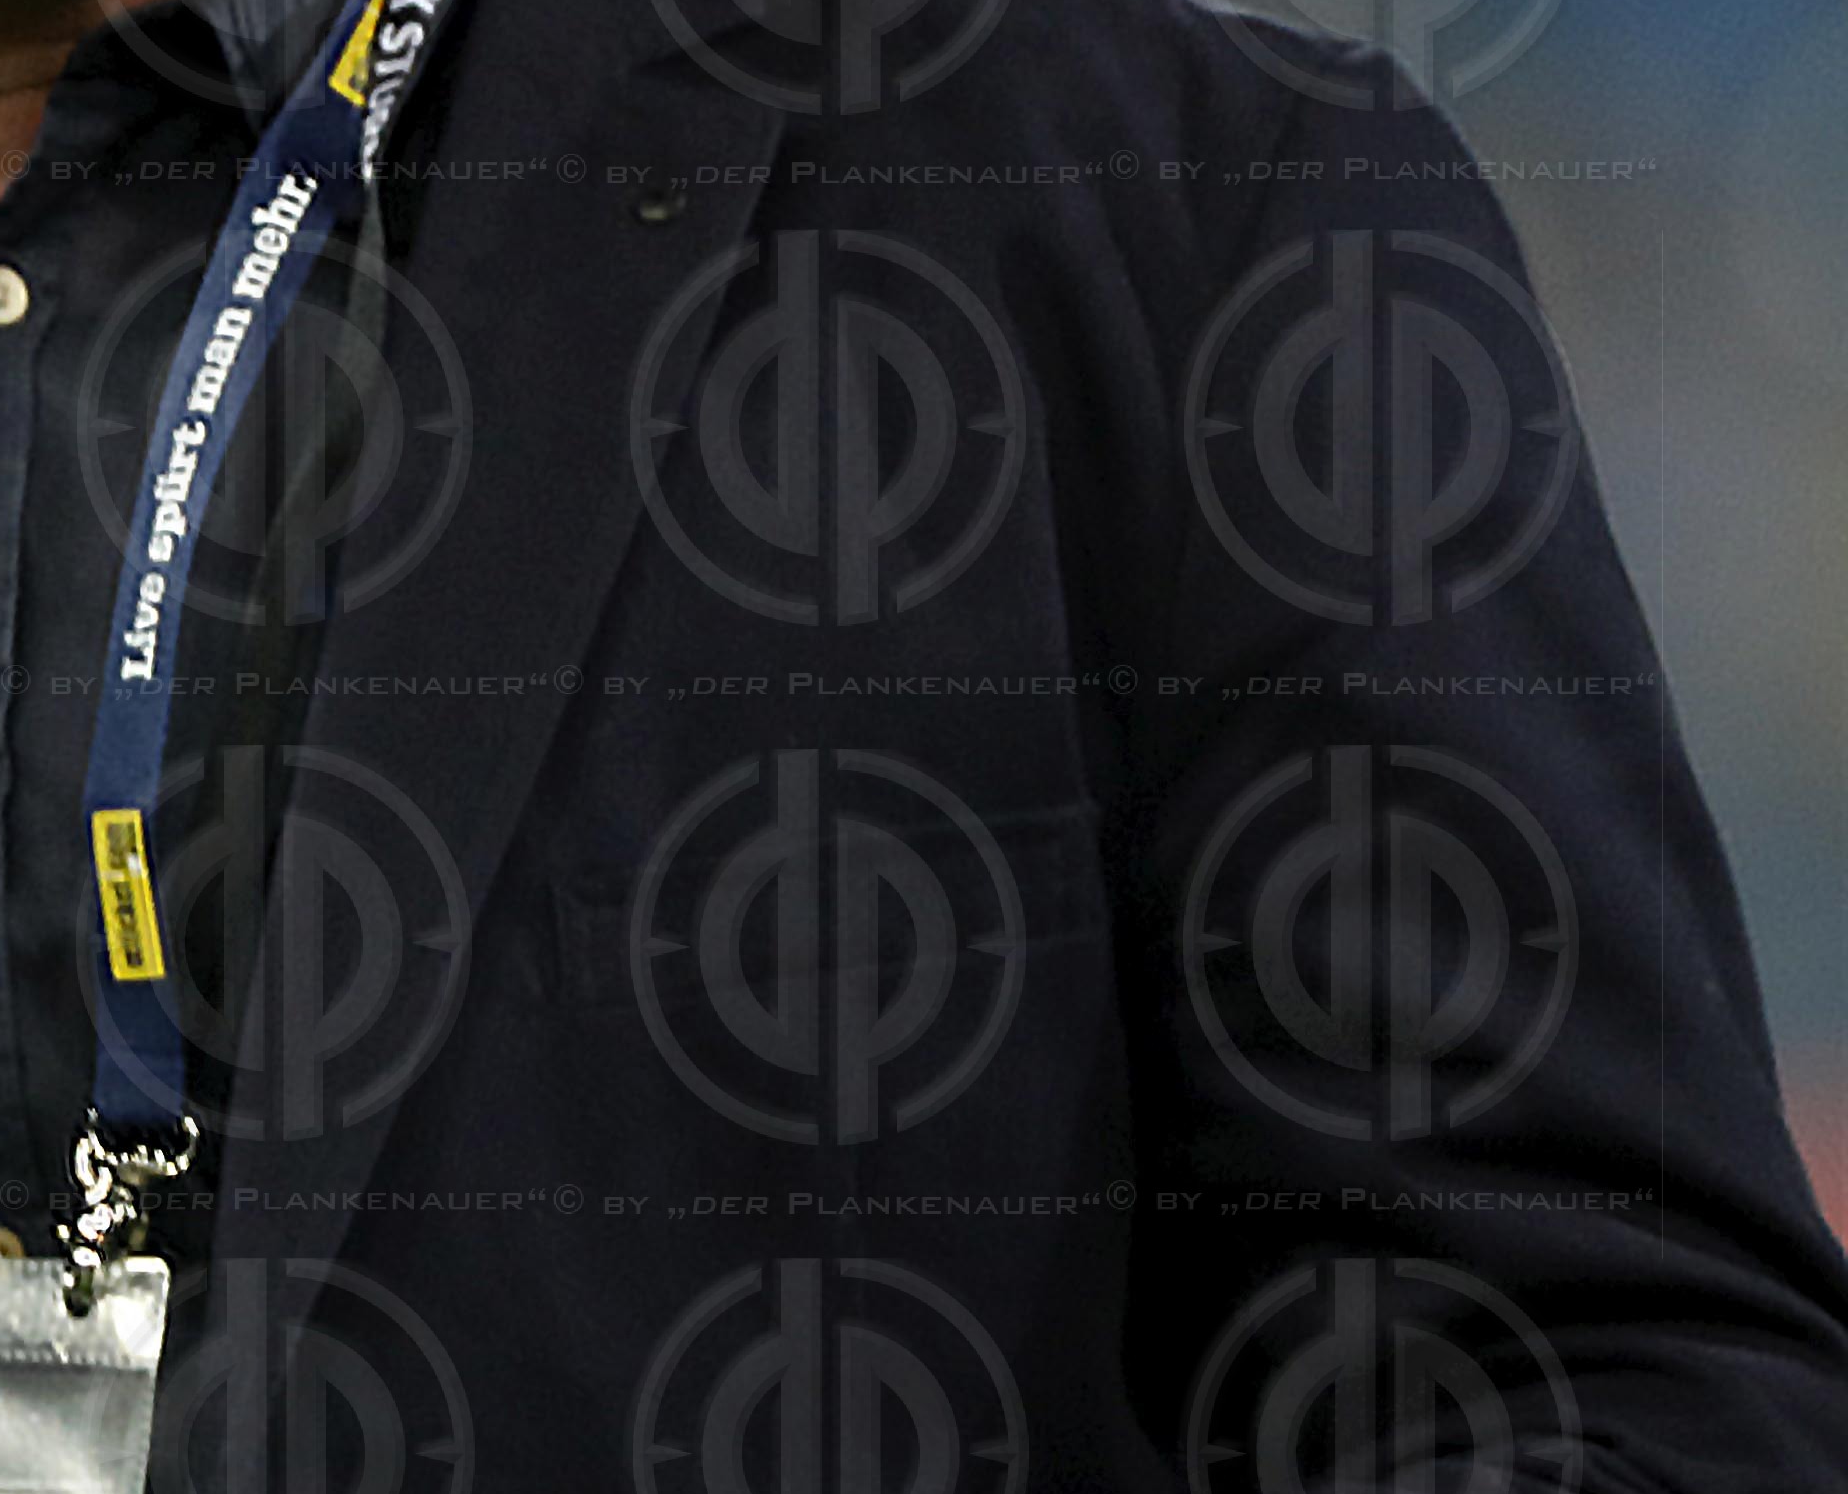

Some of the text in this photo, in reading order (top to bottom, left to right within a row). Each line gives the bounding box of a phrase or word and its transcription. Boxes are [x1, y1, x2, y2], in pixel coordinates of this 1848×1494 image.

[120, 171, 319, 682] Live spürt man mehr.
